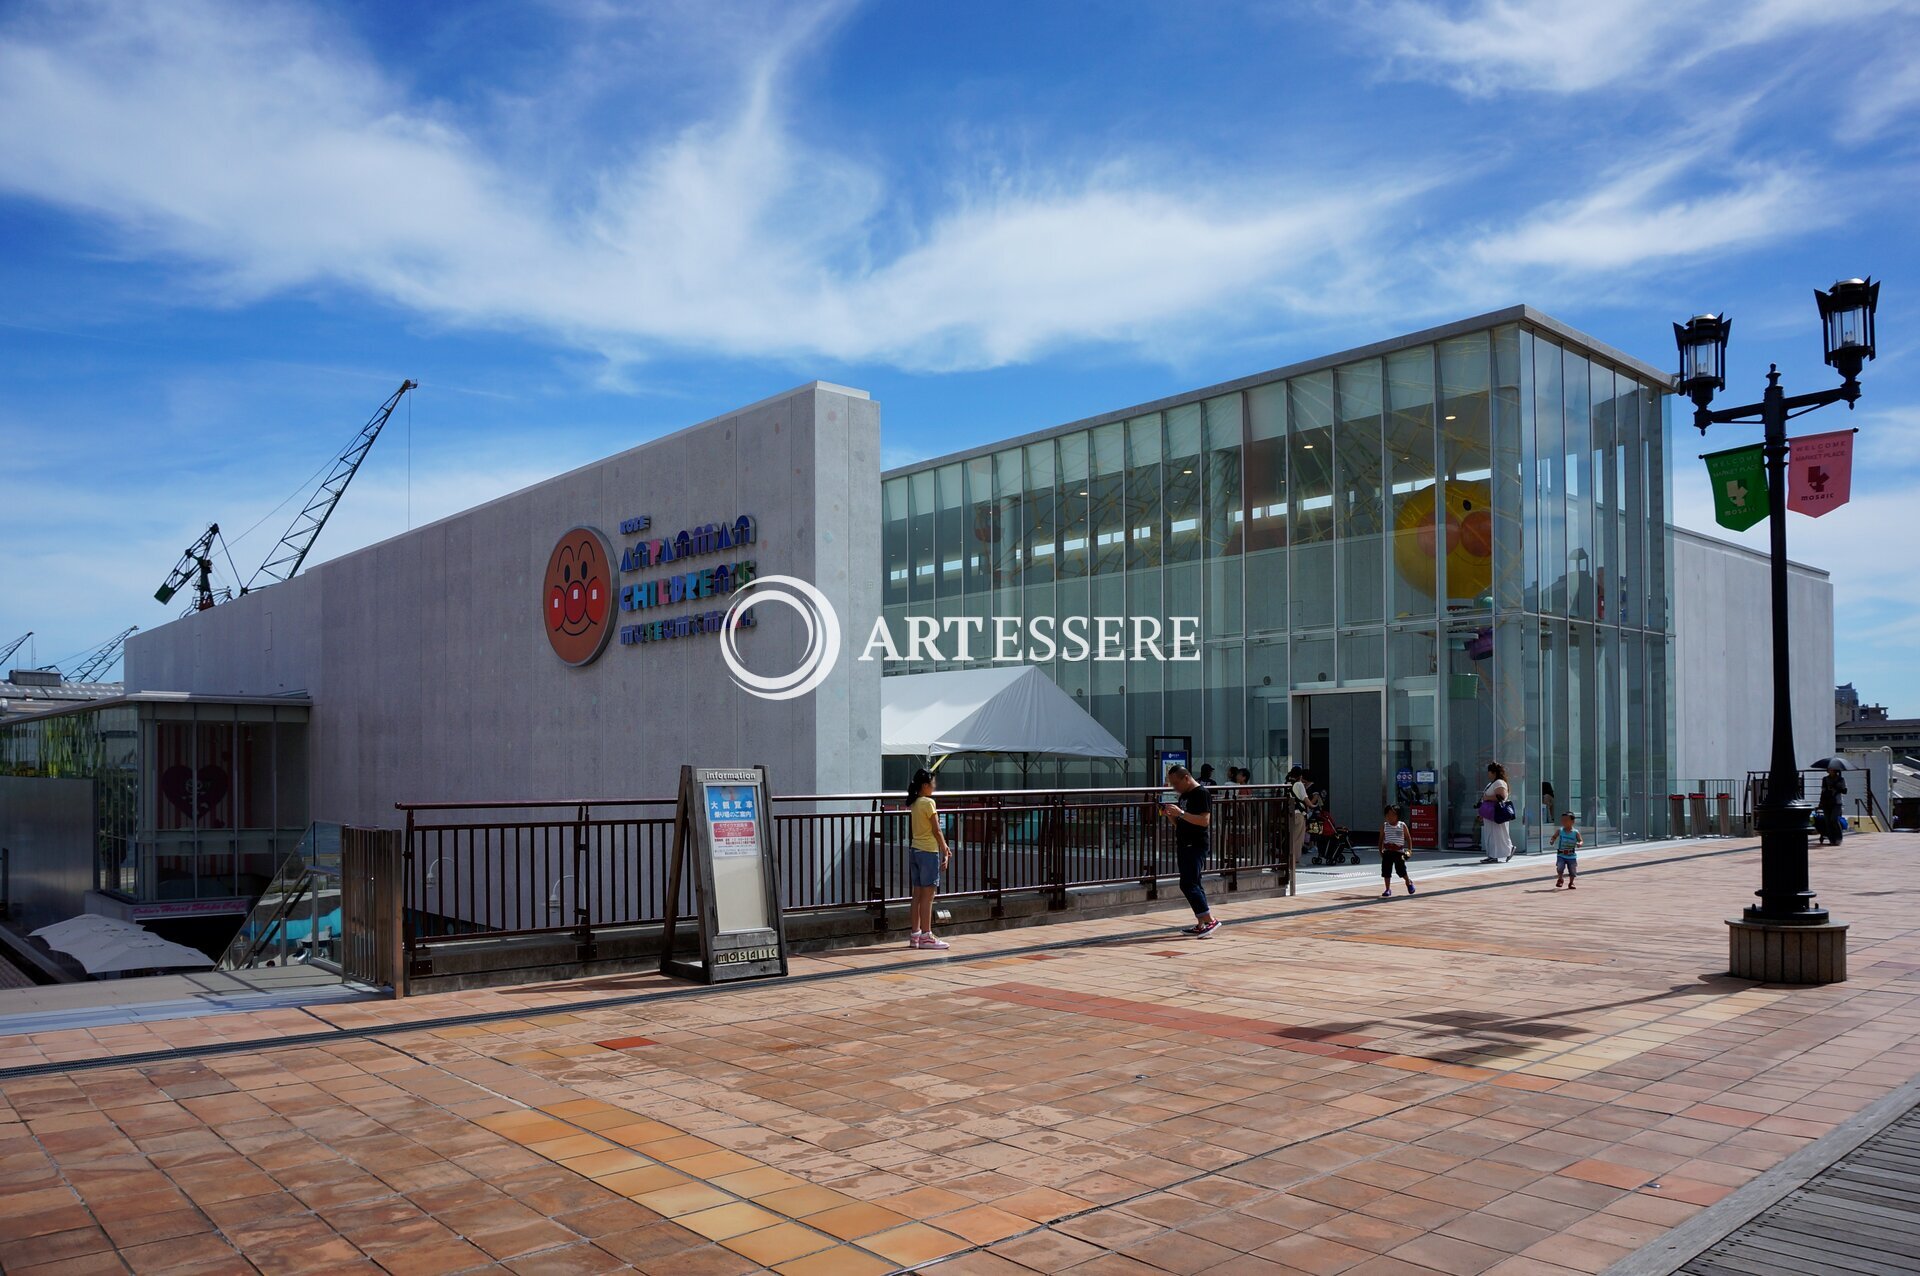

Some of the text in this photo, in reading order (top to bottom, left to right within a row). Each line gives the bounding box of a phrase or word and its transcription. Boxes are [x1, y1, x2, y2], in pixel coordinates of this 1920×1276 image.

[1796, 440, 1846, 452] WELCOME
[1712, 454, 1760, 468] WELCOME
[1795, 450, 1846, 462] MARKET PLACE
[620, 515, 650, 534] KOBE
[705, 771, 756, 780] information
